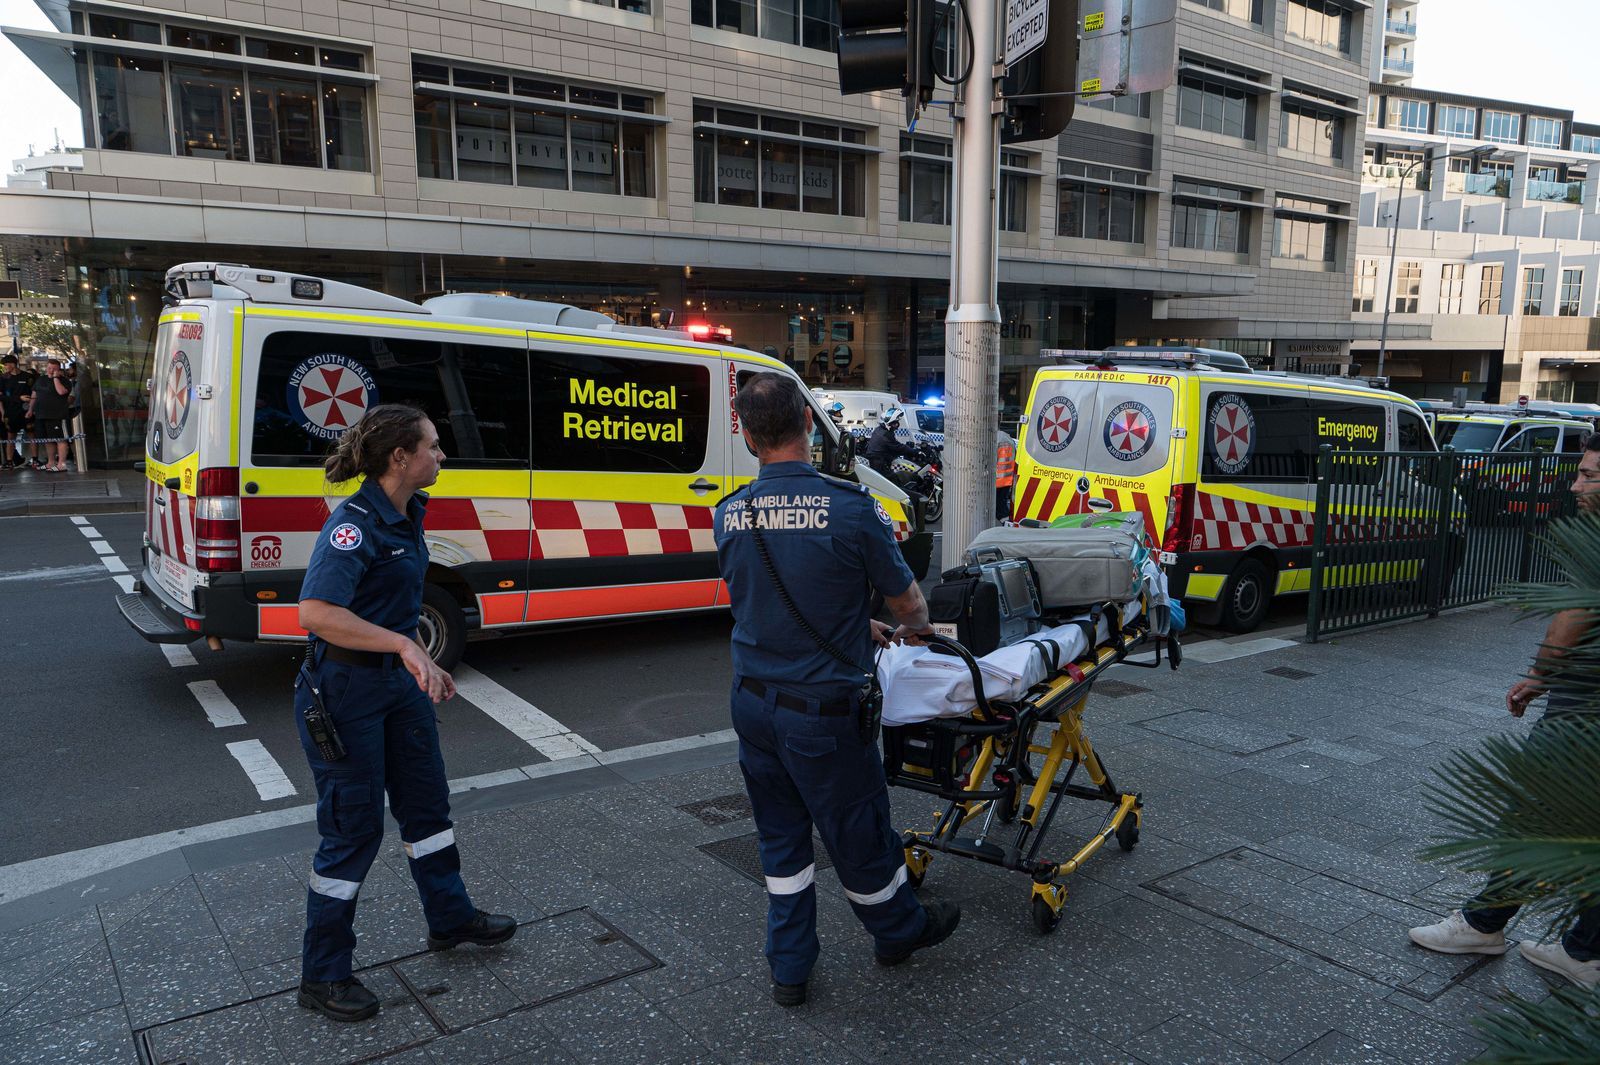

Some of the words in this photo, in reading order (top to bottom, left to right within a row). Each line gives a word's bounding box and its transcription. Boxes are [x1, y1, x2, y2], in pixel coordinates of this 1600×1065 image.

[1009, 0, 1039, 24] BICYCL
[1007, 12, 1044, 52] EXCEPTED
[457, 135, 552, 159] POTTERY
[559, 146, 608, 165] BARN
[718, 166, 766, 183] potte
[803, 170, 828, 189] kids
[289, 363, 309, 388] NEW
[307, 354, 345, 368] SOUTH
[346, 358, 376, 391] WALES
[1074, 372, 1126, 381] PARAMEDIC
[1147, 375, 1172, 386] 1417
[569, 377, 677, 410] Medical
[1107, 408, 1120, 422] NEW
[1120, 402, 1142, 411] SOUTH
[1142, 406, 1156, 430] WALES
[1209, 402, 1221, 424] NEW
[1219, 394, 1239, 406] SOUTH
[1240, 397, 1256, 428] WALES
[301, 421, 351, 440] AMBUL
[563, 412, 683, 443] Retrieval
[1317, 417, 1378, 443] Emergency
[1107, 445, 1146, 461] AMBULANCE
[1214, 455, 1250, 474] AMBULANCE
[1032, 466, 1074, 481] Emergency
[1094, 475, 1146, 491] Ambulance
[725, 498, 747, 513] NSW
[750, 495, 831, 508] AMBULANCE
[723, 508, 829, 534] PARAMEDIC
[251, 546, 282, 561] 000
